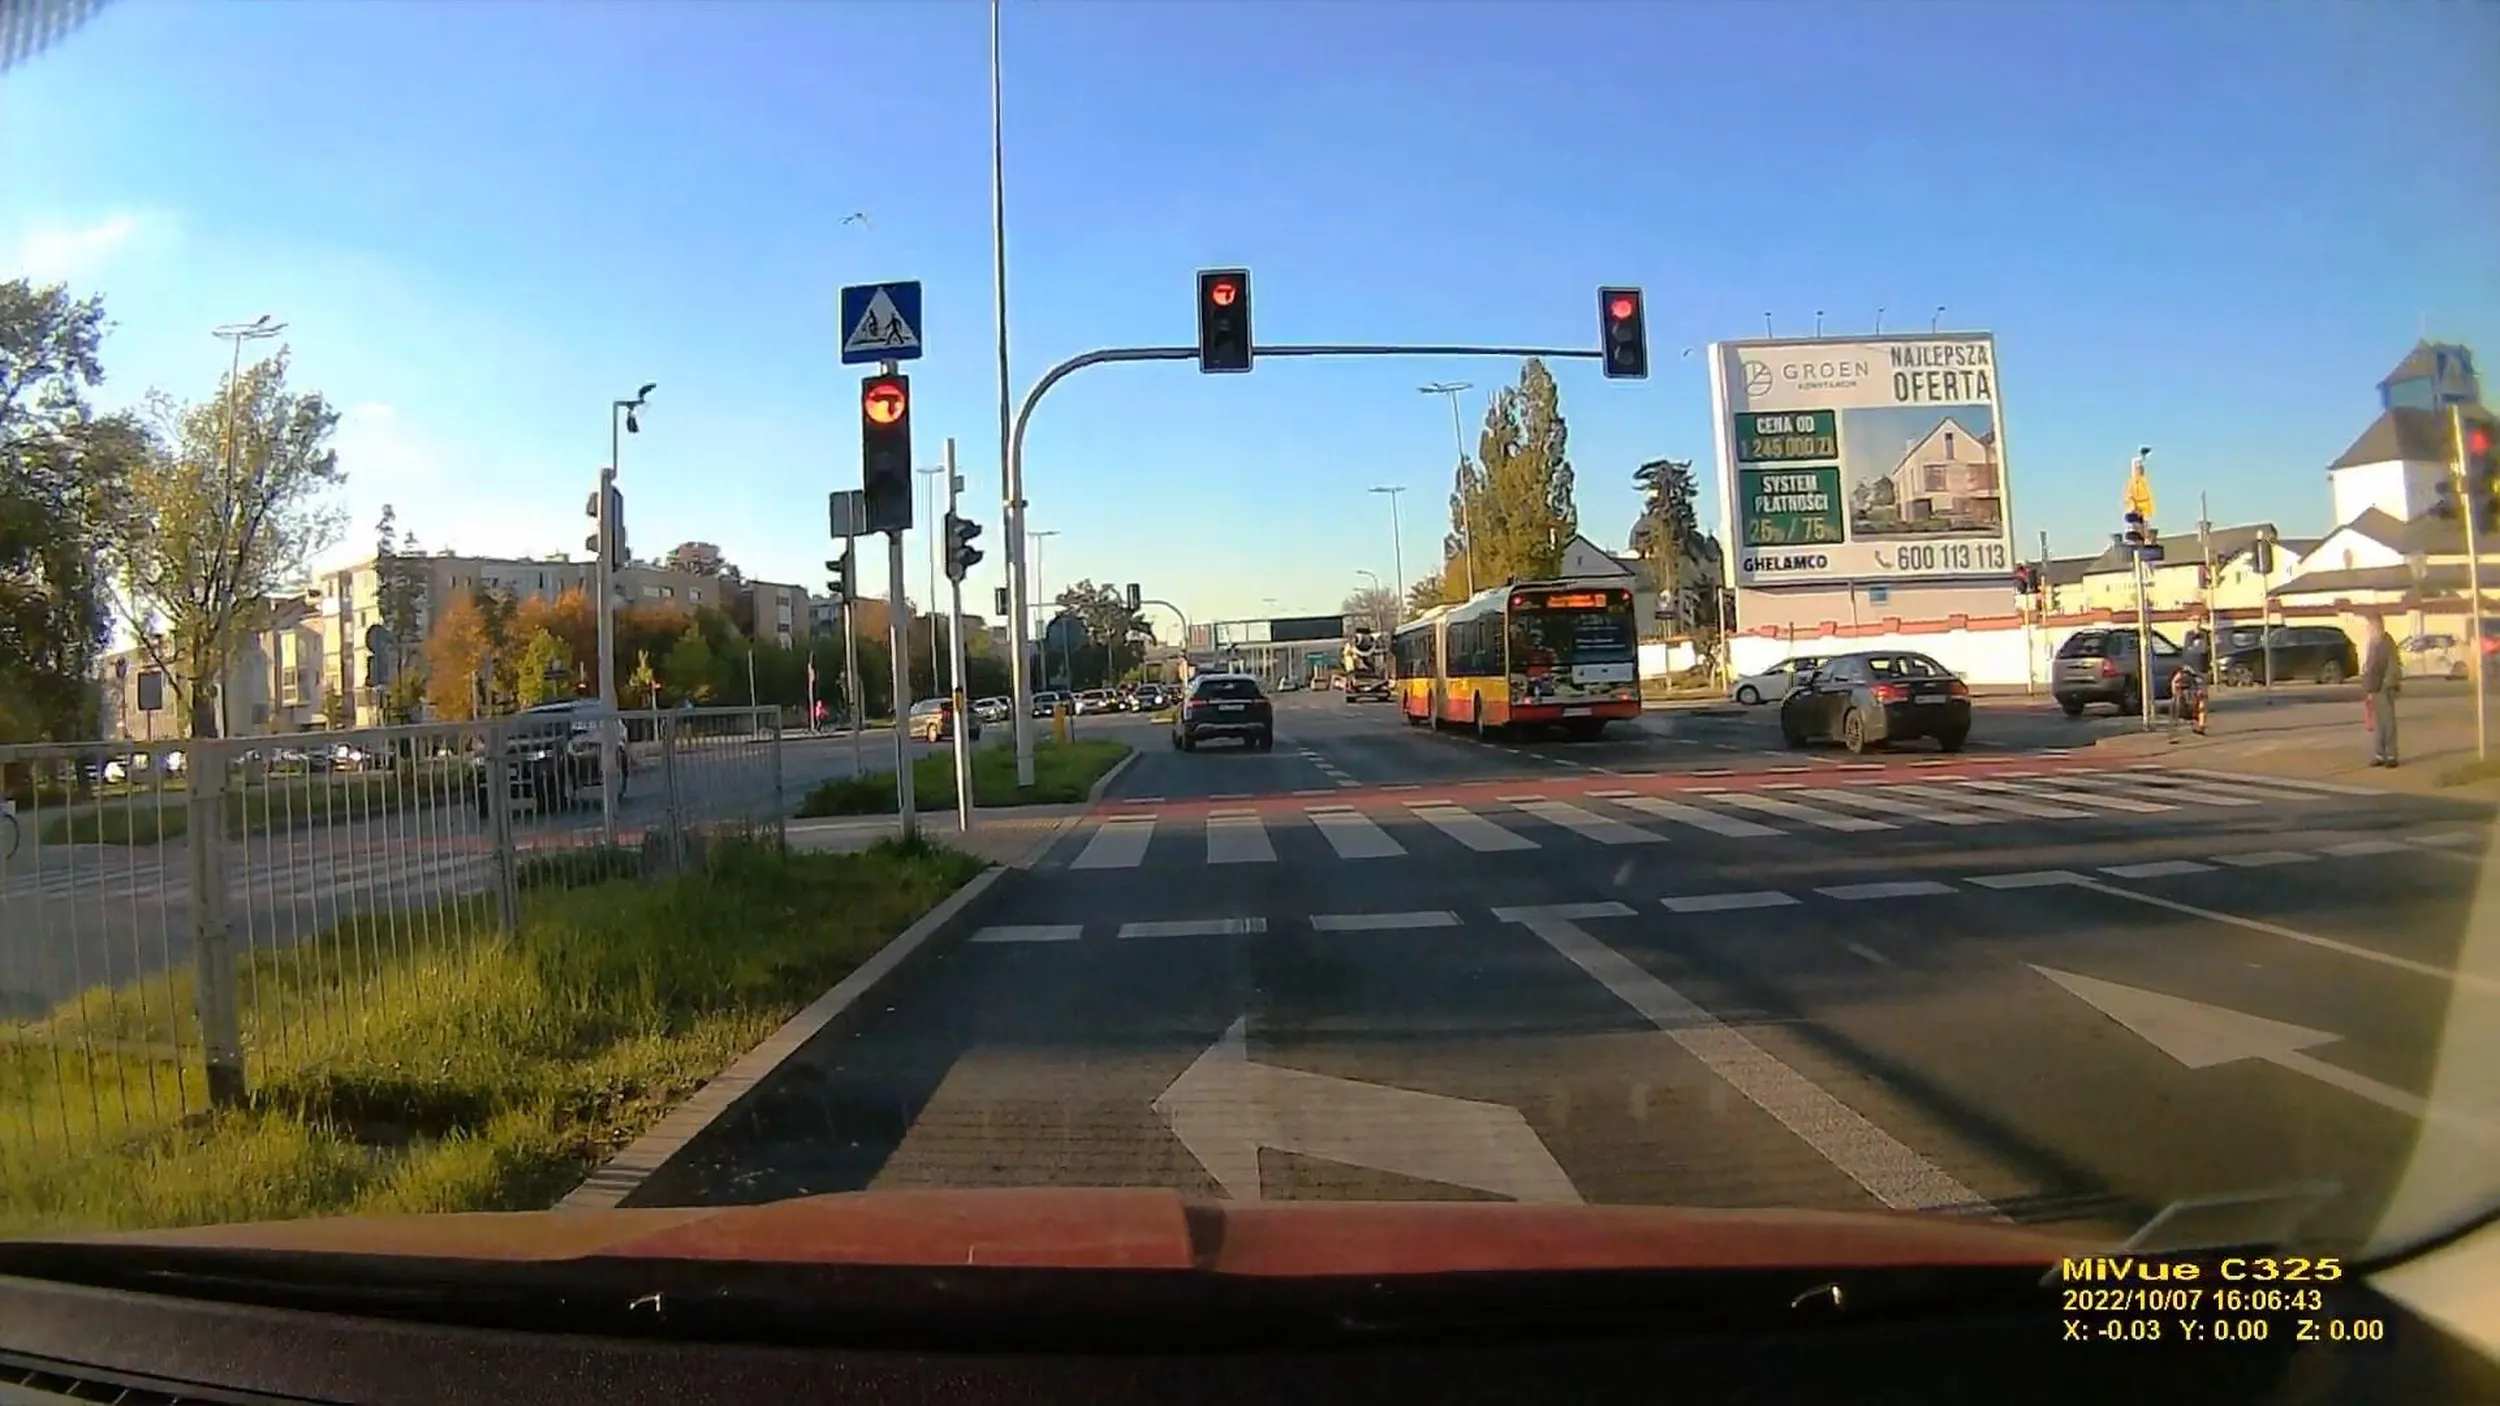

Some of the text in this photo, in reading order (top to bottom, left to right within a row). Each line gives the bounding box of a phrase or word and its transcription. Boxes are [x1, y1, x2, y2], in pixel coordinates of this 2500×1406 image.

[1890, 344, 1990, 367] NAJLEPSZA
[1783, 361, 1869, 380] GROEN
[1893, 369, 1992, 402] OFERTA
[1756, 415, 1816, 434] CENA OD
[1785, 437, 1815, 457] 000
[1762, 474, 1818, 493] SYSTEM
[1755, 491, 1829, 513] PŁATNOŚCI
[1743, 554, 1828, 572] GHELAMCO
[1897, 544, 2006, 571] 600 113 113
